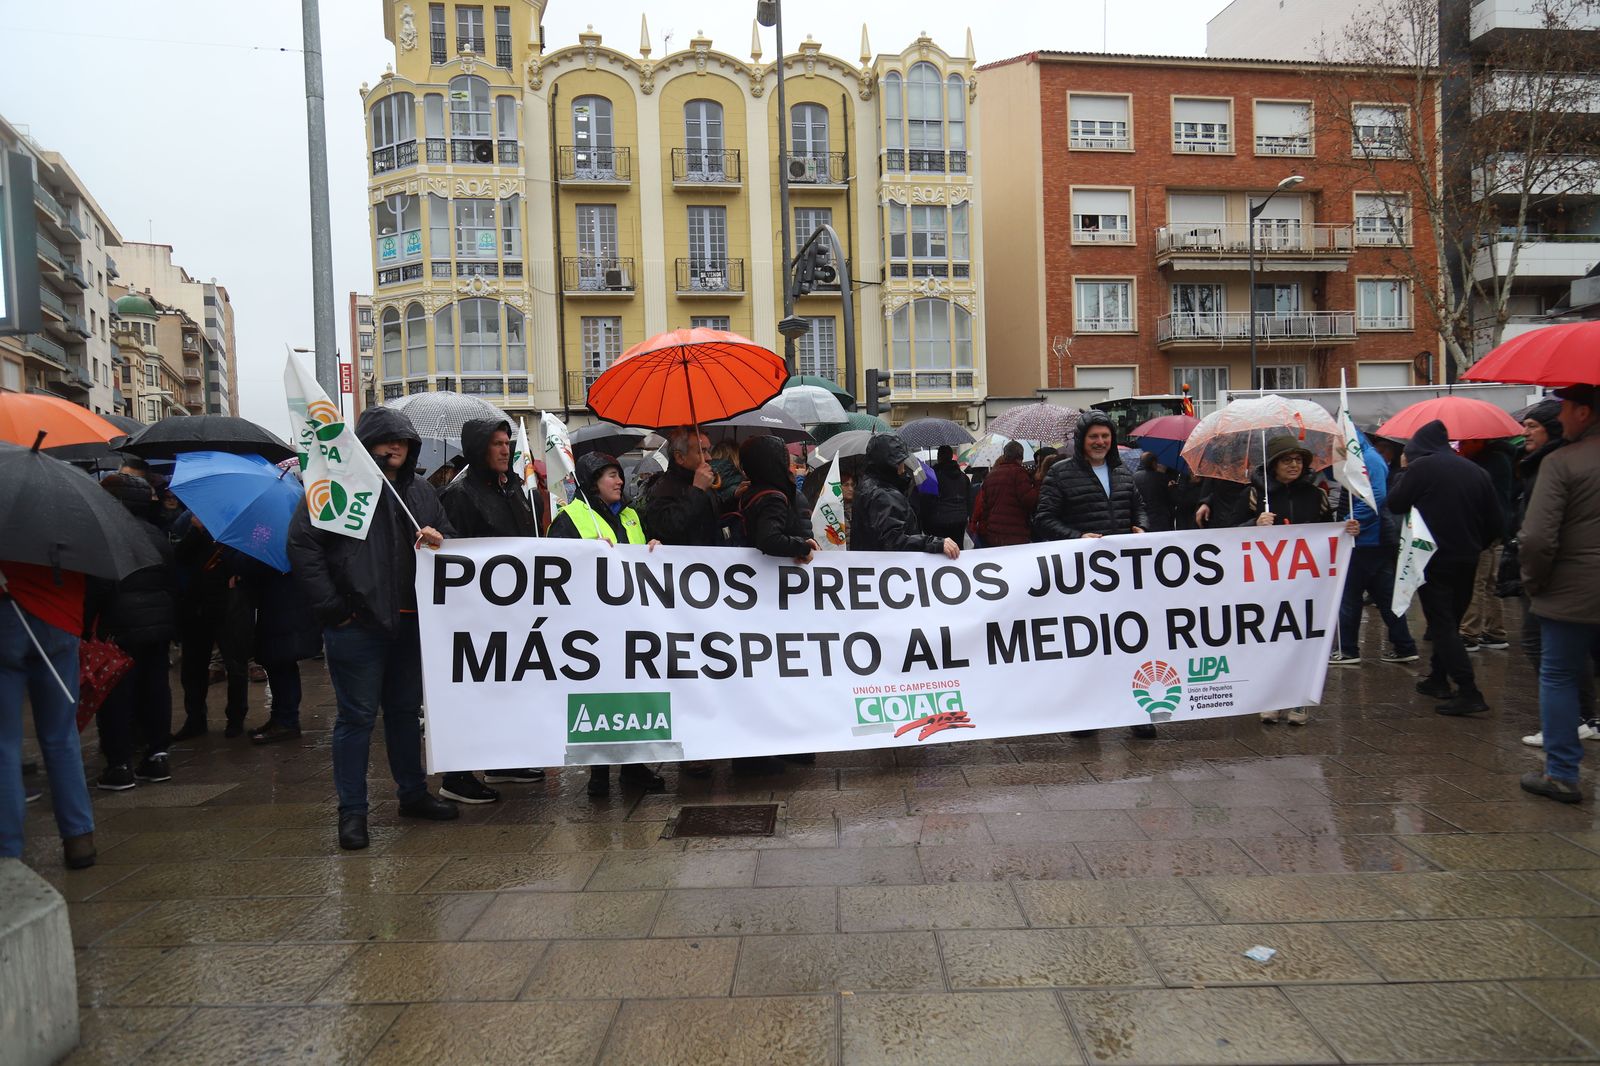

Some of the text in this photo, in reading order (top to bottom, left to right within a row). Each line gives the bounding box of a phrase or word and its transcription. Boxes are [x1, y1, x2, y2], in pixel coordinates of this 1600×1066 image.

[342, 365, 350, 391] CCOO
[319, 444, 342, 463] PA
[344, 491, 373, 531] UPA
[432, 536, 1339, 611] POR UNOS PRECIOS JUSTOS ¡YA!
[452, 599, 1326, 683] MÁS RESPETO AL MEDIO RURAL
[1188, 656, 1230, 682] UPA
[853, 680, 960, 695] UNIÓN DE CAMPESINOS
[1189, 693, 1233, 702] Agricultores
[1209, 685, 1232, 693] Pequeños
[857, 692, 962, 723] COAG
[1196, 701, 1234, 709] Ganaderos
